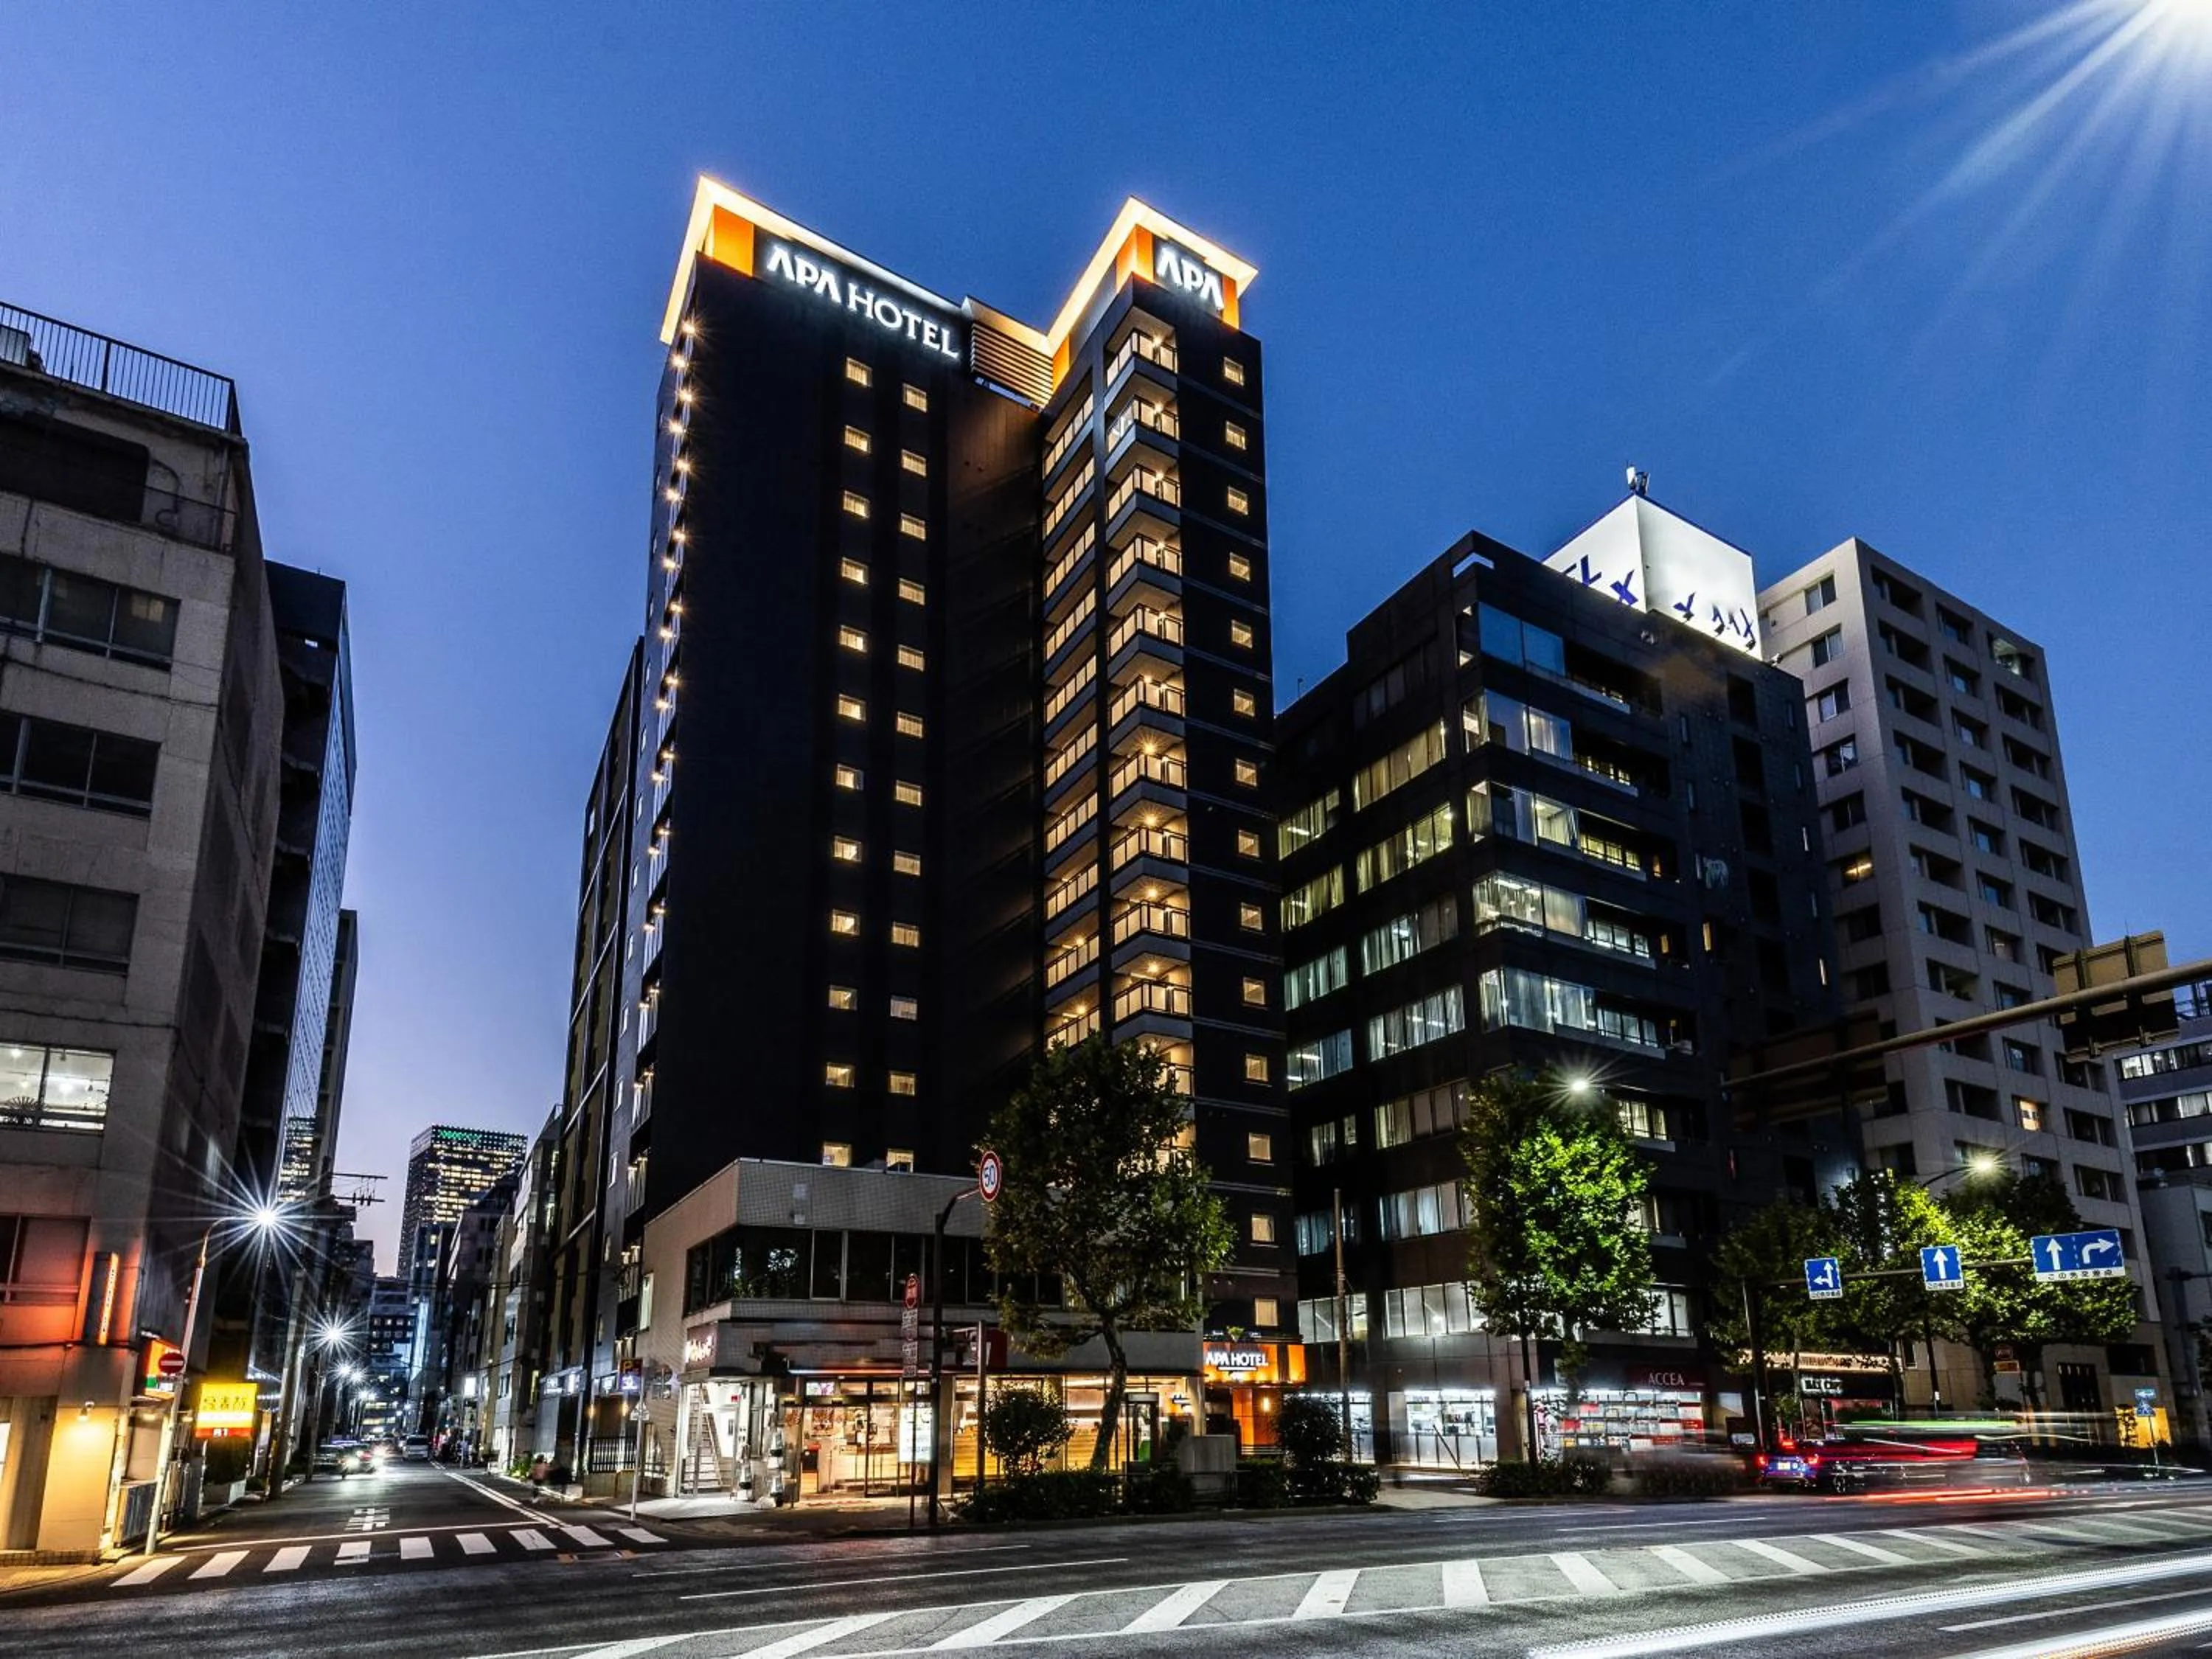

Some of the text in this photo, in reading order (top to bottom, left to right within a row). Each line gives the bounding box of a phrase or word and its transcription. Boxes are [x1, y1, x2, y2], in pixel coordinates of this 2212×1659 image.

[1155, 246, 1225, 310] APA
[767, 246, 959, 360] APA HOTEL
[984, 1165, 996, 1187] 50
[1206, 1352, 1269, 1366] APA HOTEL
[1648, 1372, 1686, 1386] ACCEA
